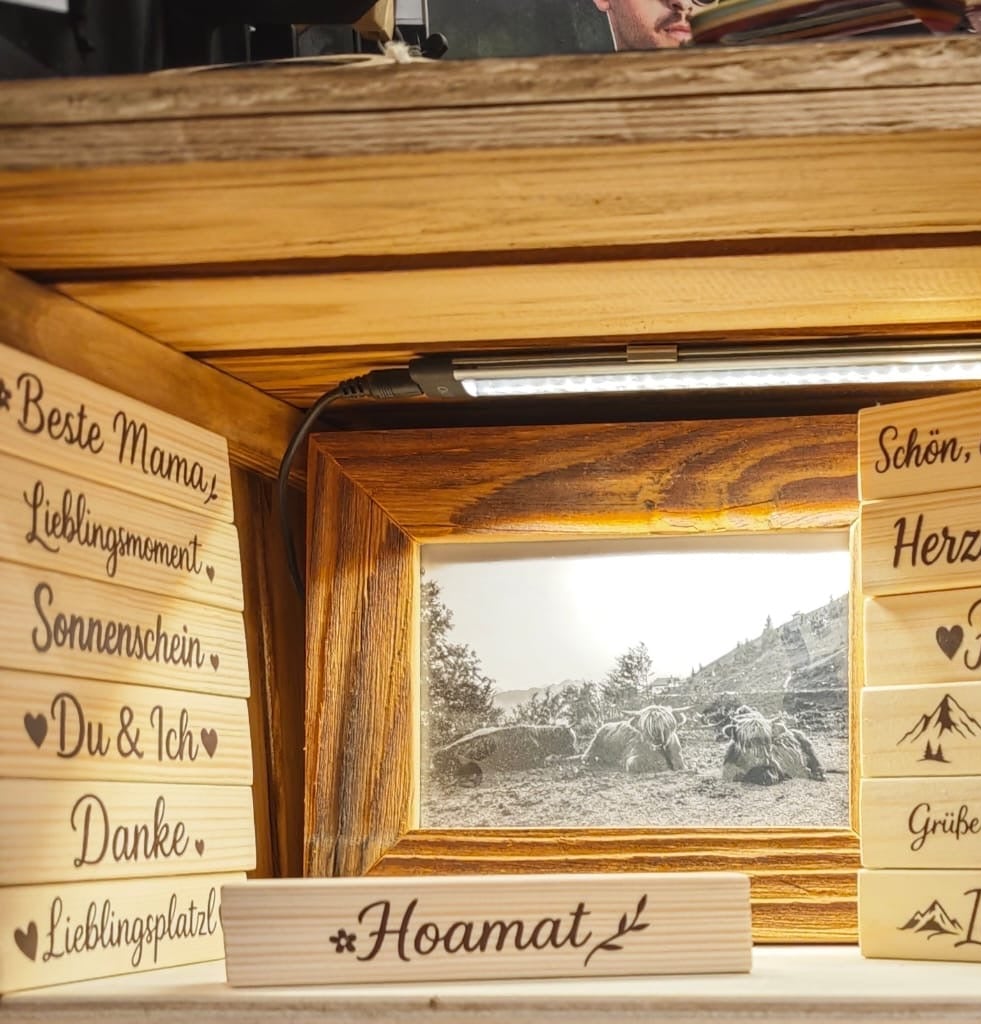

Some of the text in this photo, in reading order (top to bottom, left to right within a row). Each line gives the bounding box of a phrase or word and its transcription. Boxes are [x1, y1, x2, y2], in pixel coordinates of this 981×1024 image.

[17, 372, 208, 494] Beste Mama
[874, 425, 971, 474] Schön,
[24, 480, 204, 578] Lieblingsmoment
[31, 582, 205, 668] Sonnenschein
[50, 692, 200, 762] Du & Ich
[70, 794, 190, 868] Danke
[42, 887, 218, 968] Lieblingsplatzl
[356, 897, 593, 963] Hoamat
